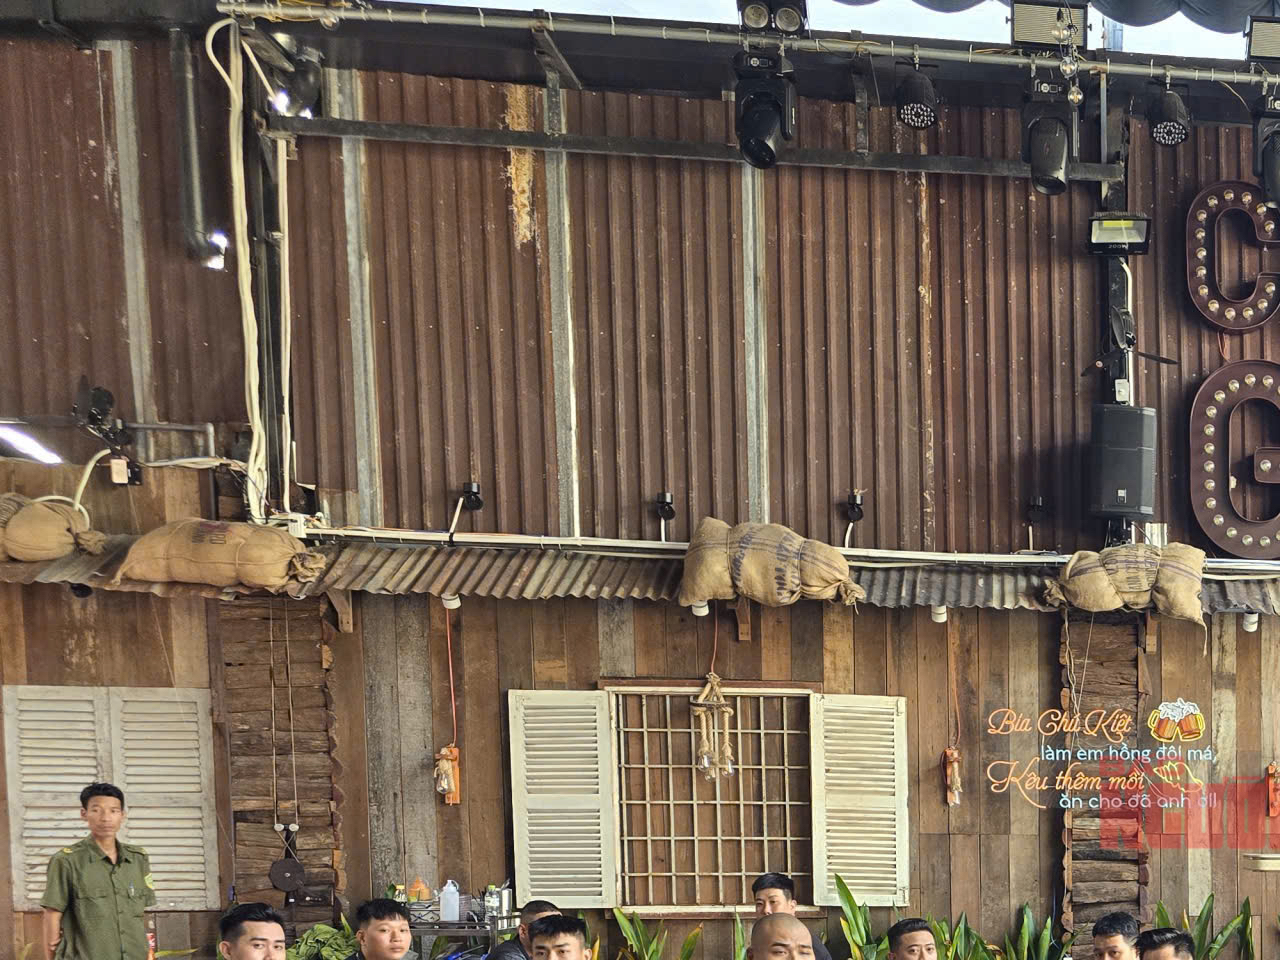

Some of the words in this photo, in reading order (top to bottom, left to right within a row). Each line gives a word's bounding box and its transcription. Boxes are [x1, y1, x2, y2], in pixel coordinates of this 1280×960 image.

[987, 708, 1032, 735] Bia
[1037, 709, 1081, 736] Chú
[1083, 708, 1132, 743] Kiệt
[1041, 745, 1071, 761] làm
[1076, 748, 1103, 761] em
[1109, 742, 1150, 764] hồng
[1156, 745, 1182, 761] đôi
[987, 757, 1048, 808] Kêu
[1055, 762, 1102, 790] thêm
[1109, 767, 1145, 790] mồi
[1059, 792, 1084, 809] ăn
[1089, 793, 1122, 809] cho
[1127, 792, 1151, 809] đã
[1157, 793, 1192, 809] anh
